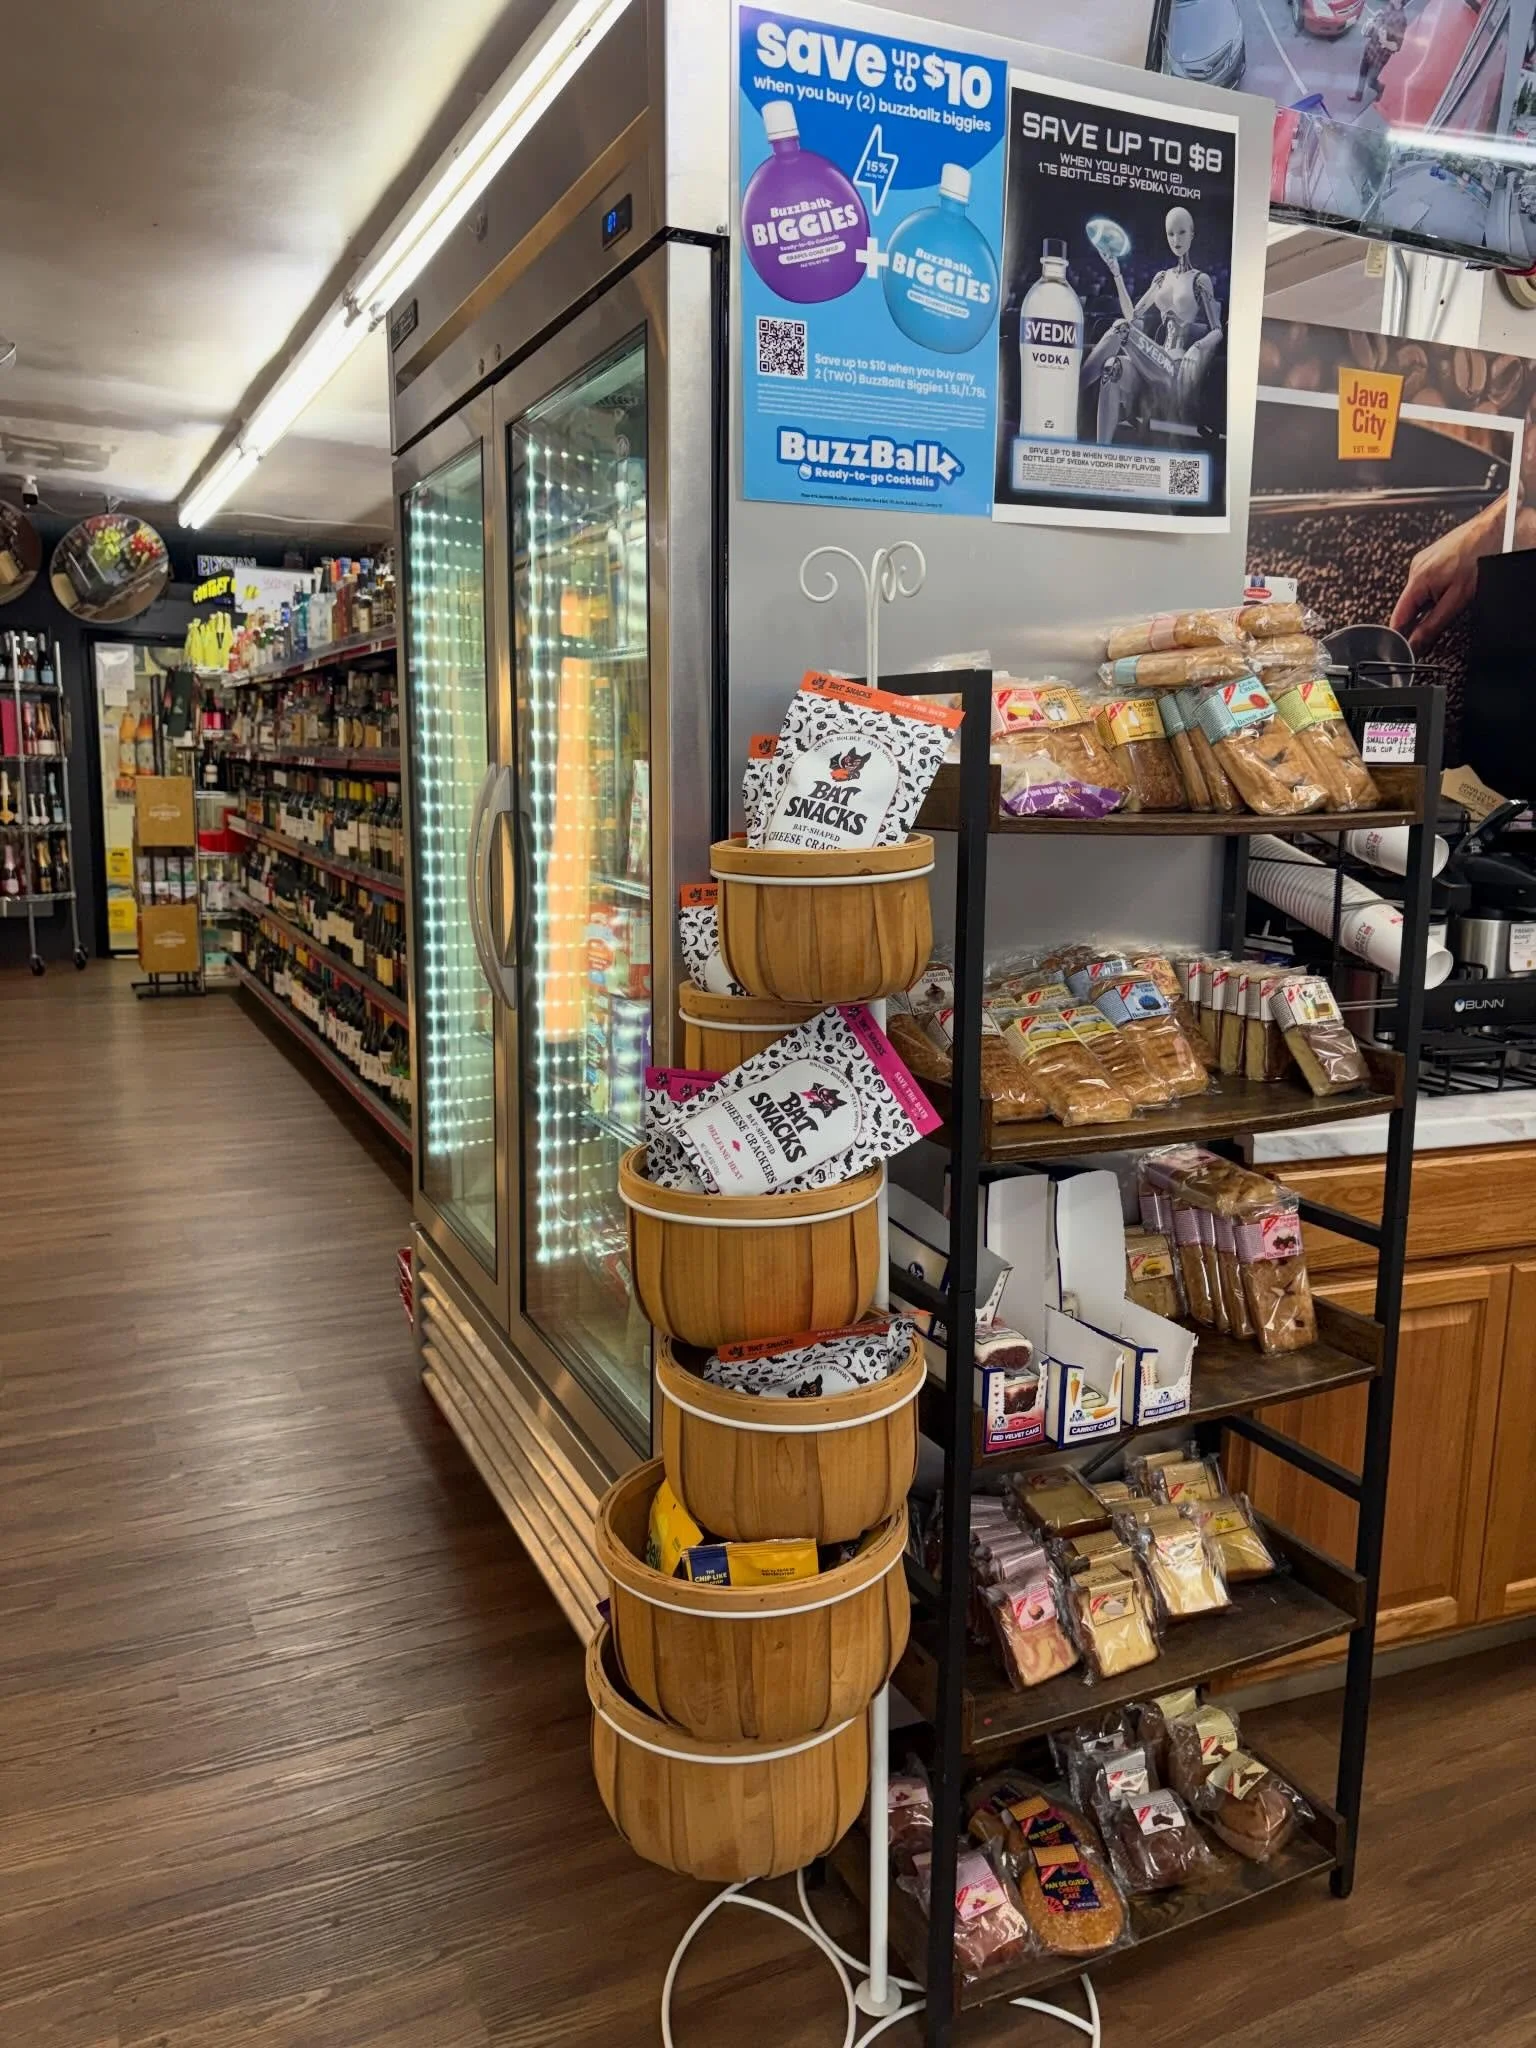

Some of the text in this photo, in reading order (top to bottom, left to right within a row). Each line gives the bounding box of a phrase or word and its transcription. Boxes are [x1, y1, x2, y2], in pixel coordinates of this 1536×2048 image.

[756, 22, 993, 110] save up to $10
[753, 75, 991, 134] when you buy (2) buzzballz biggies
[1022, 111, 1223, 173] SAVE UP TO $8
[865, 160, 889, 175] 15%
[1038, 161, 1201, 200] 1.75 BOTTLES OF SVEDKA VODKA
[1059, 152, 1183, 184] WHEN YOU BUY TWO (2)
[770, 197, 834, 219] BuzzBallz
[751, 204, 859, 247] BIGGIES
[892, 251, 991, 305] BIGGIES
[1024, 320, 1078, 345] SVEDKA
[815, 353, 975, 385] Save up to $10 when you buy any
[1032, 352, 1070, 366] VODKA
[815, 371, 821, 379] 2
[823, 370, 857, 386] (TWO)
[907, 381, 943, 395] Biggies
[1347, 381, 1388, 409] Java
[1352, 408, 1386, 440] City
[780, 430, 958, 481] BuzzBallz
[1022, 454, 1055, 464] BOTTLES
[1067, 458, 1089, 466] SVEDKA
[1090, 460, 1114, 469] VODKA
[1029, 447, 1049, 455] SAVE
[1050, 448, 1061, 456] UP
[1061, 449, 1071, 457] TO
[1082, 451, 1103, 459] WHEN
[1103, 453, 1118, 461] YOU
[1118, 454, 1133, 462] BUY
[815, 467, 934, 488] Ready-to-go Cocktails
[829, 682, 873, 699] BAT SNACKS
[808, 780, 862, 807] BAT
[784, 796, 868, 836] SNACKS
[768, 832, 803, 845] CHEESE
[792, 823, 841, 842] BAT-SHAPED
[1465, 999, 1504, 1009] BUNN
[894, 1071, 928, 1119] SAVE THE BATS
[777, 1091, 819, 1133] BAT
[746, 1113, 776, 1155] BAT-SHAPED
[748, 1092, 808, 1164] SNACKS
[707, 1123, 731, 1161] HELLFANG
[727, 1160, 744, 1181] HEAT
[722, 1101, 778, 1186] CHEESE CRACKERS
[829, 1365, 852, 1383] SPOOKY
[992, 1427, 1040, 1442] RED VELVET CAKE
[1071, 1420, 1116, 1434] CARROT CAKE
